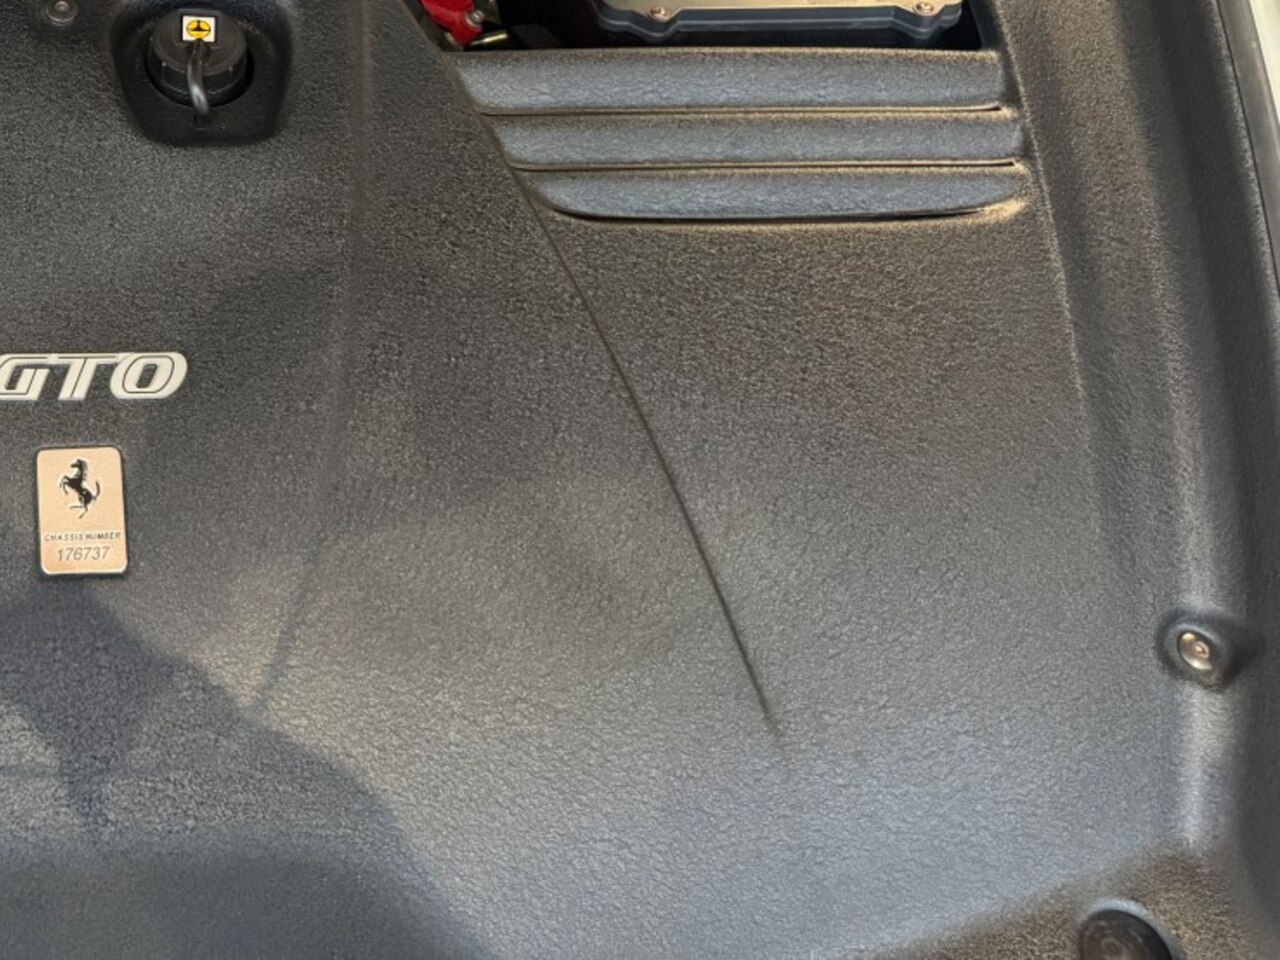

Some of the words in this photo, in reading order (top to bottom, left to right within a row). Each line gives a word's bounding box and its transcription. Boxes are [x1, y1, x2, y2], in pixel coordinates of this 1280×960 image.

[43, 533, 84, 542] CHASSIS
[85, 531, 121, 540] NUMBER
[57, 545, 111, 562] 176737
